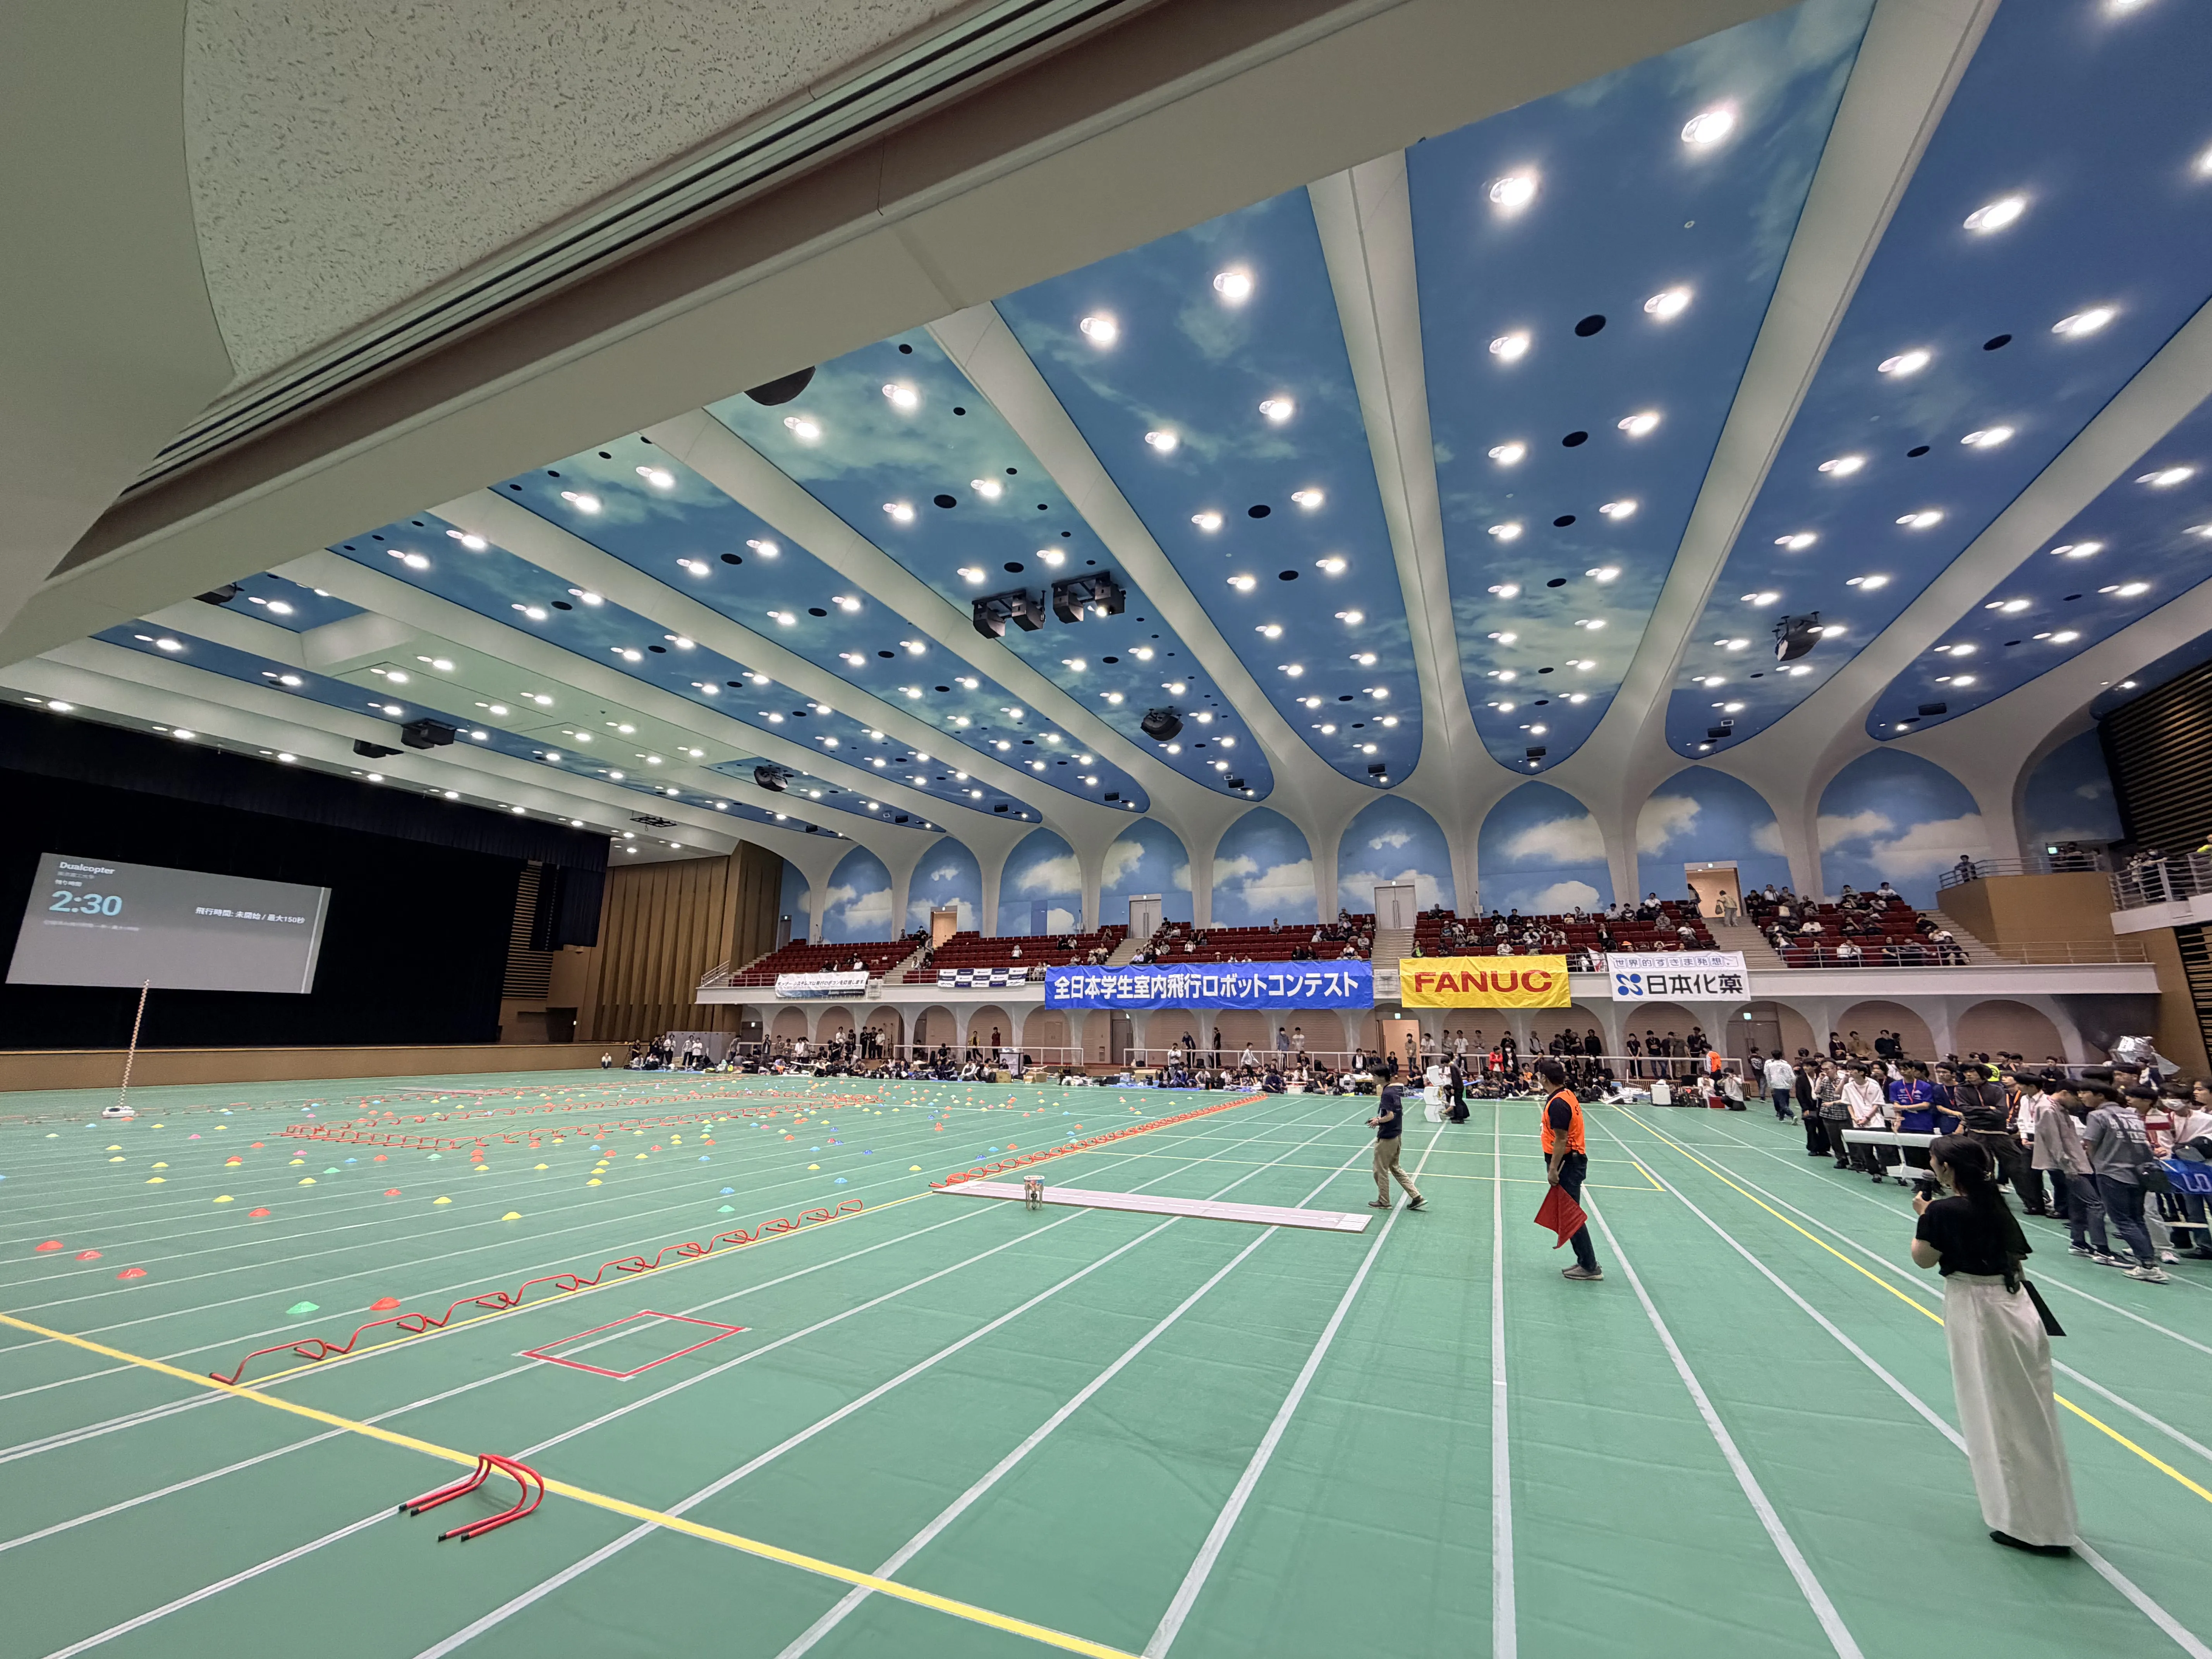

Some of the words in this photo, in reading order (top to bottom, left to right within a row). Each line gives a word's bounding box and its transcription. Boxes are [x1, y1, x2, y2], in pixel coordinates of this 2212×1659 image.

[59, 862, 115, 874] Dualcopter
[49, 890, 122, 916] 2:30
[235, 911, 260, 920] 未開始
[1615, 956, 1731, 967] 世界的すきま発想。
[1054, 972, 1358, 999] 全日本学生室内飛行ロボットコンテスト
[1414, 969, 1552, 993] FANUC
[1646, 974, 1743, 994] 日本化薬
